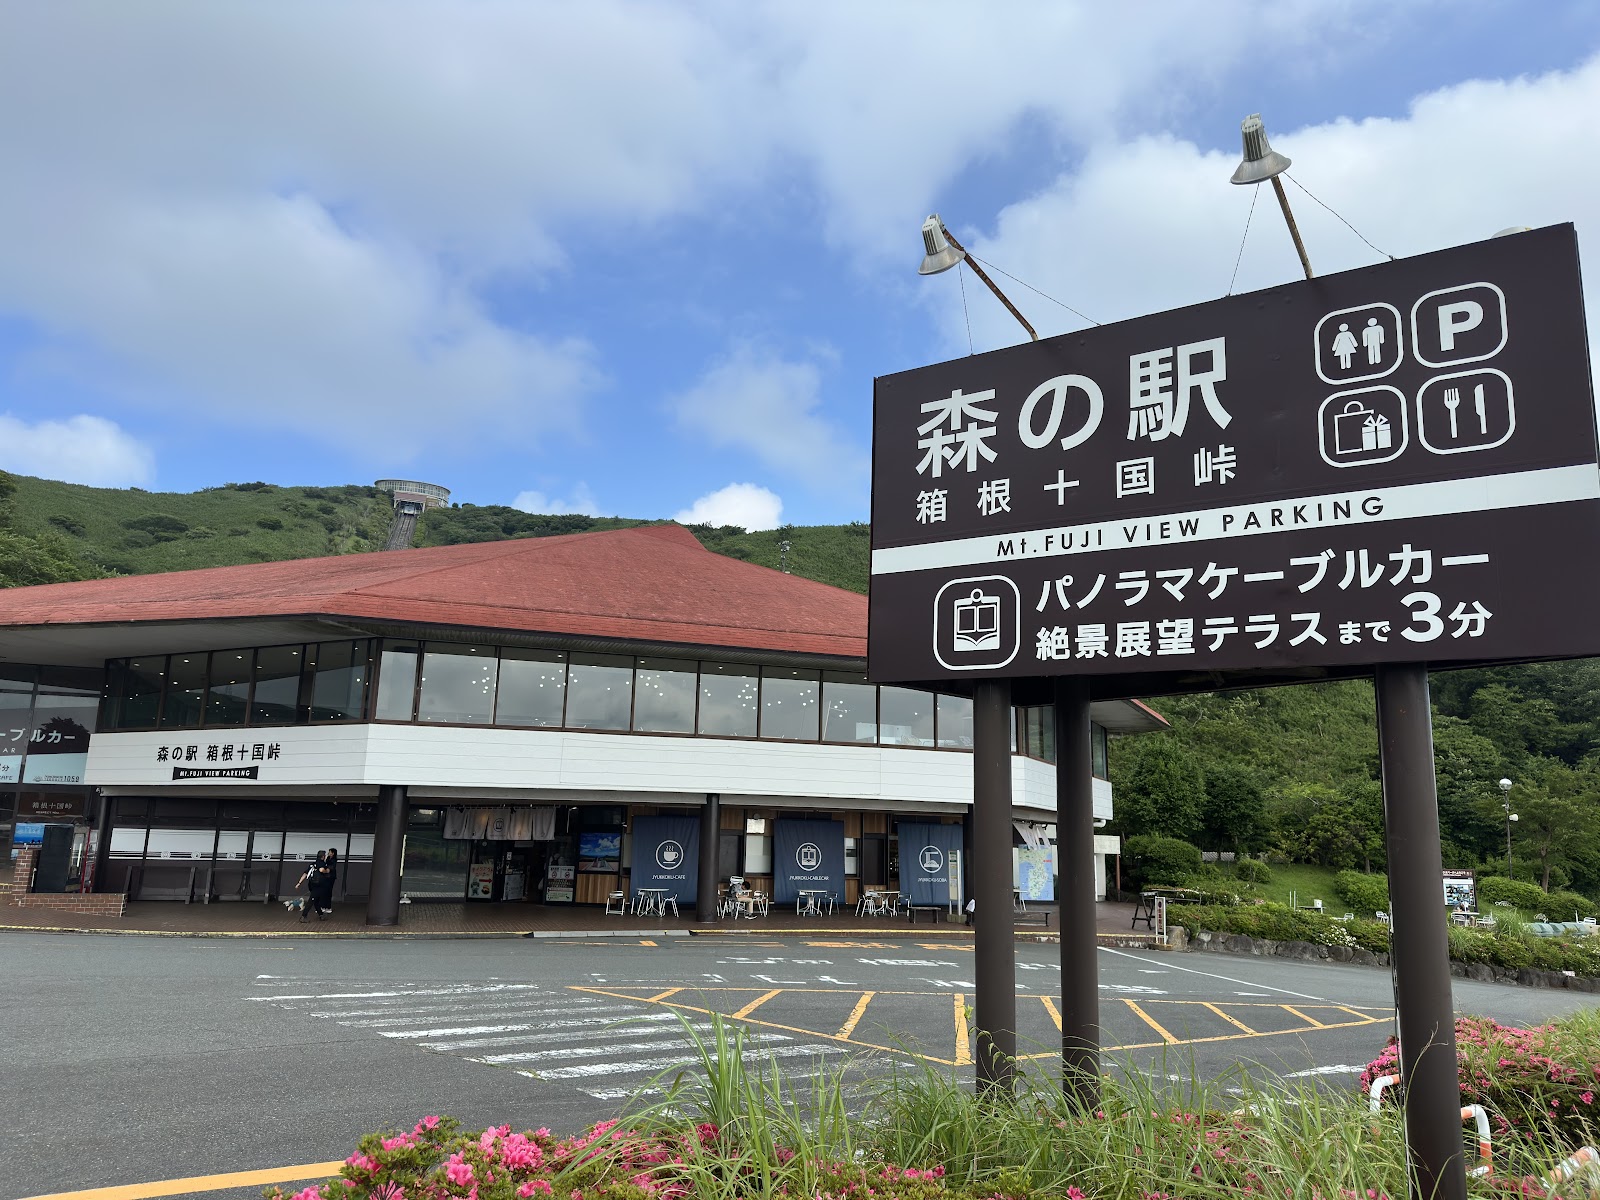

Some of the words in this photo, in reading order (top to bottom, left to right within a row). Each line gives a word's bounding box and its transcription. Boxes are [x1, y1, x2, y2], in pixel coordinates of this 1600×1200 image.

[1438, 300, 1484, 352] P
[916, 336, 1233, 479] 森の駅
[916, 444, 1237, 525] 箱根十国峠
[996, 528, 1103, 557] Mt.FUJI
[1122, 517, 1200, 543] VIEW
[1221, 496, 1385, 532] PARKING
[1036, 543, 1490, 612] パノラマケーブルカー
[156, 746, 198, 762] 森の駅
[206, 743, 281, 761] 箱根十国峠
[222, 769, 251, 777] PARKING
